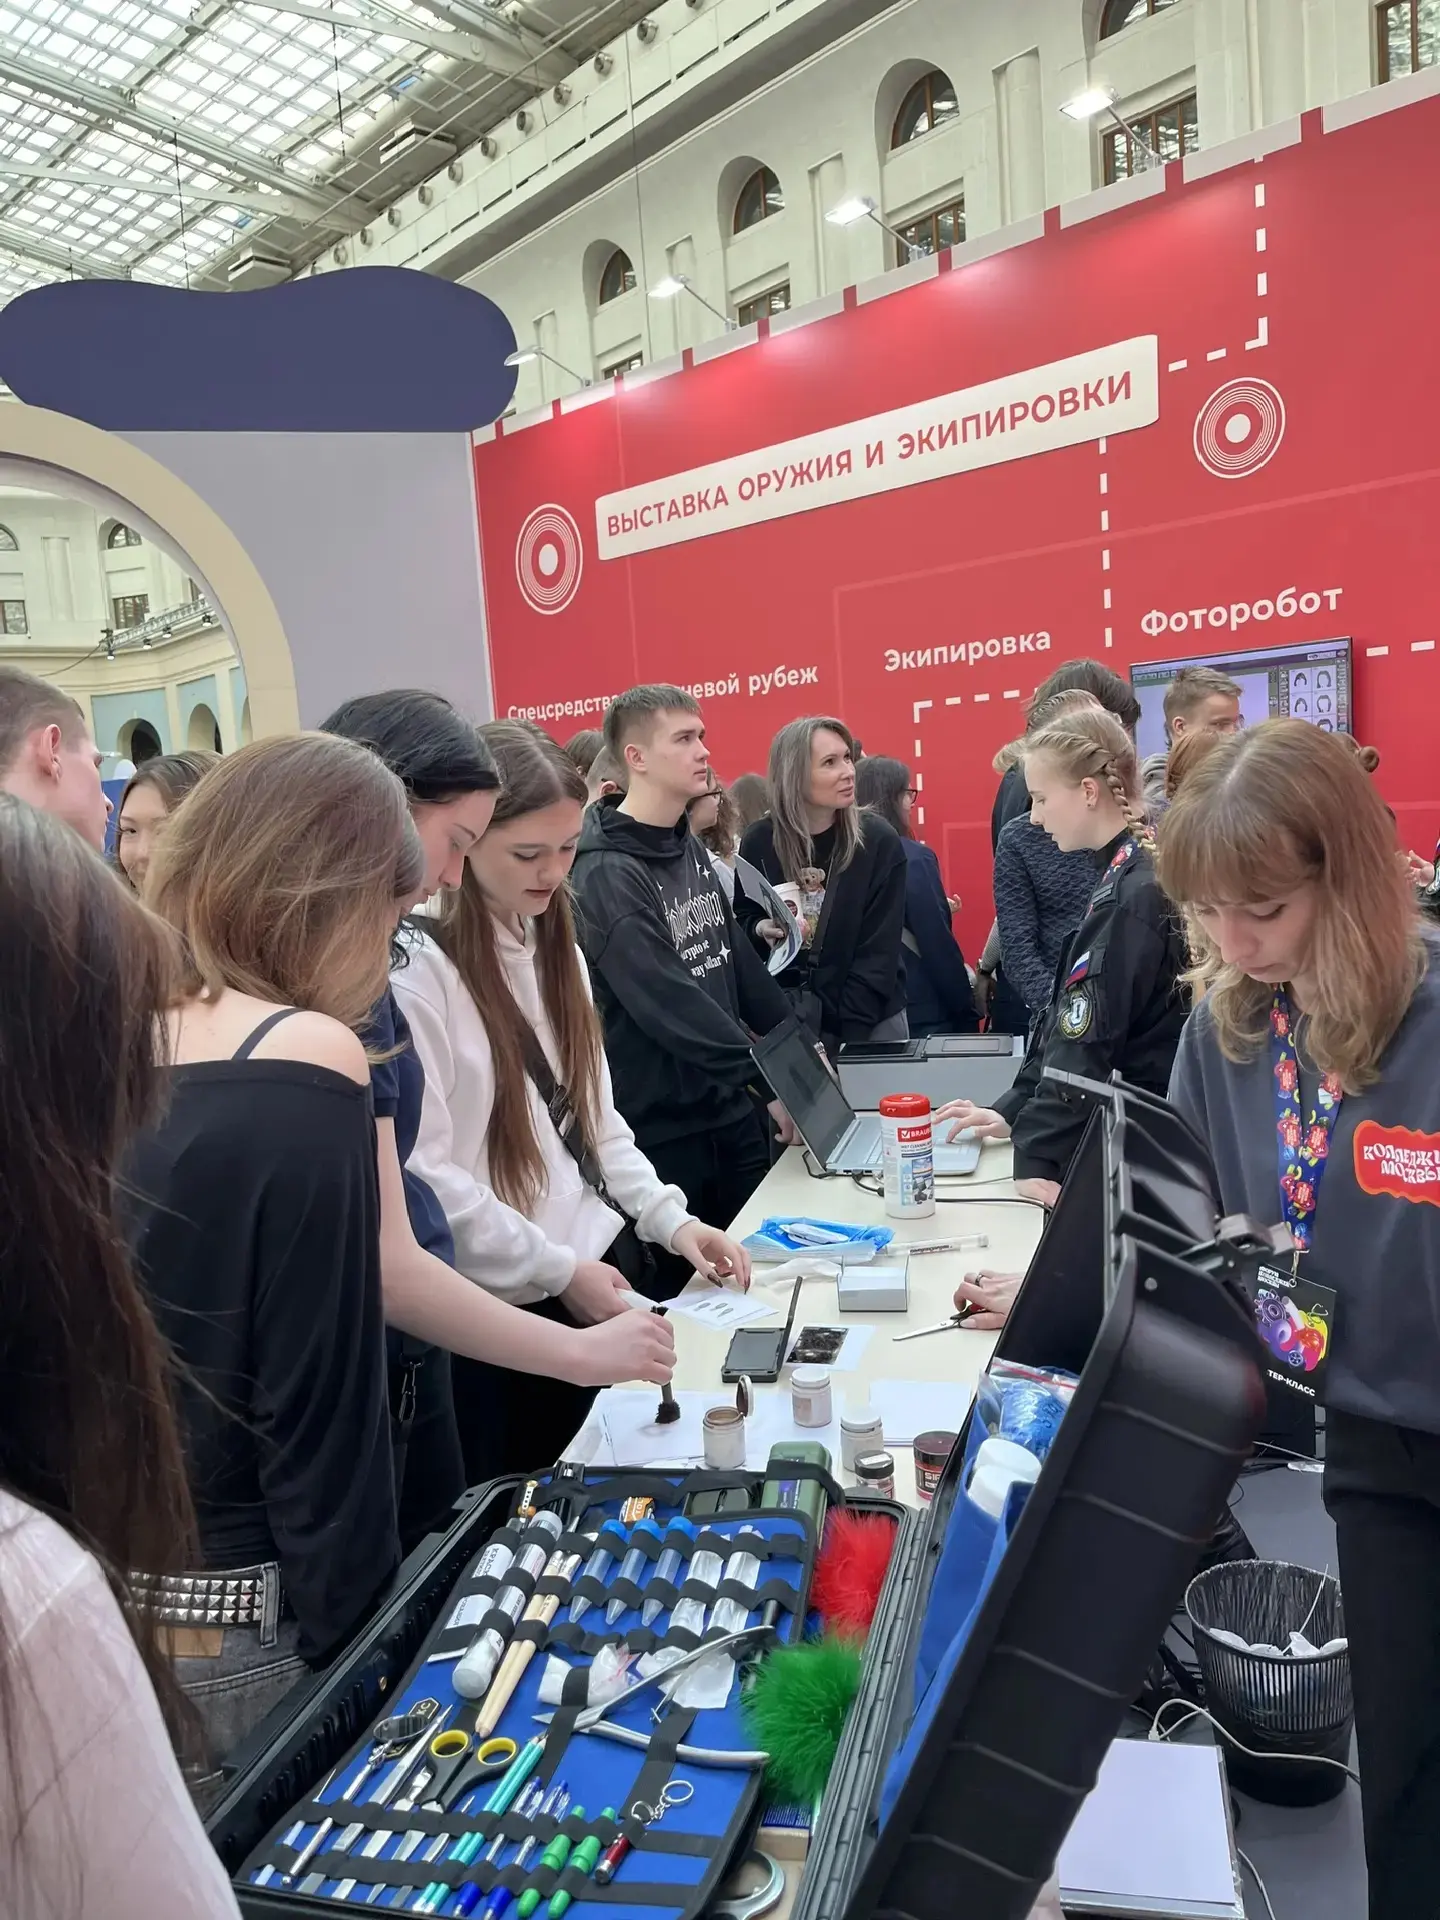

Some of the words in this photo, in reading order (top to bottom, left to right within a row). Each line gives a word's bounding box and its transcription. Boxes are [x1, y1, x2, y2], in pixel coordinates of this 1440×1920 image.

[607, 485, 729, 537] ВЫСТАВКА
[738, 449, 852, 501] ОРУЖИЯ
[865, 440, 884, 469] И
[897, 370, 1132, 460] ЭКИПИРОВКИ
[1140, 586, 1343, 637] Фоторобот
[883, 630, 1051, 673] Экипировка
[748, 664, 819, 697] рубеж
[1267, 1369, 1316, 1397] ТЕР-КЛАСС
